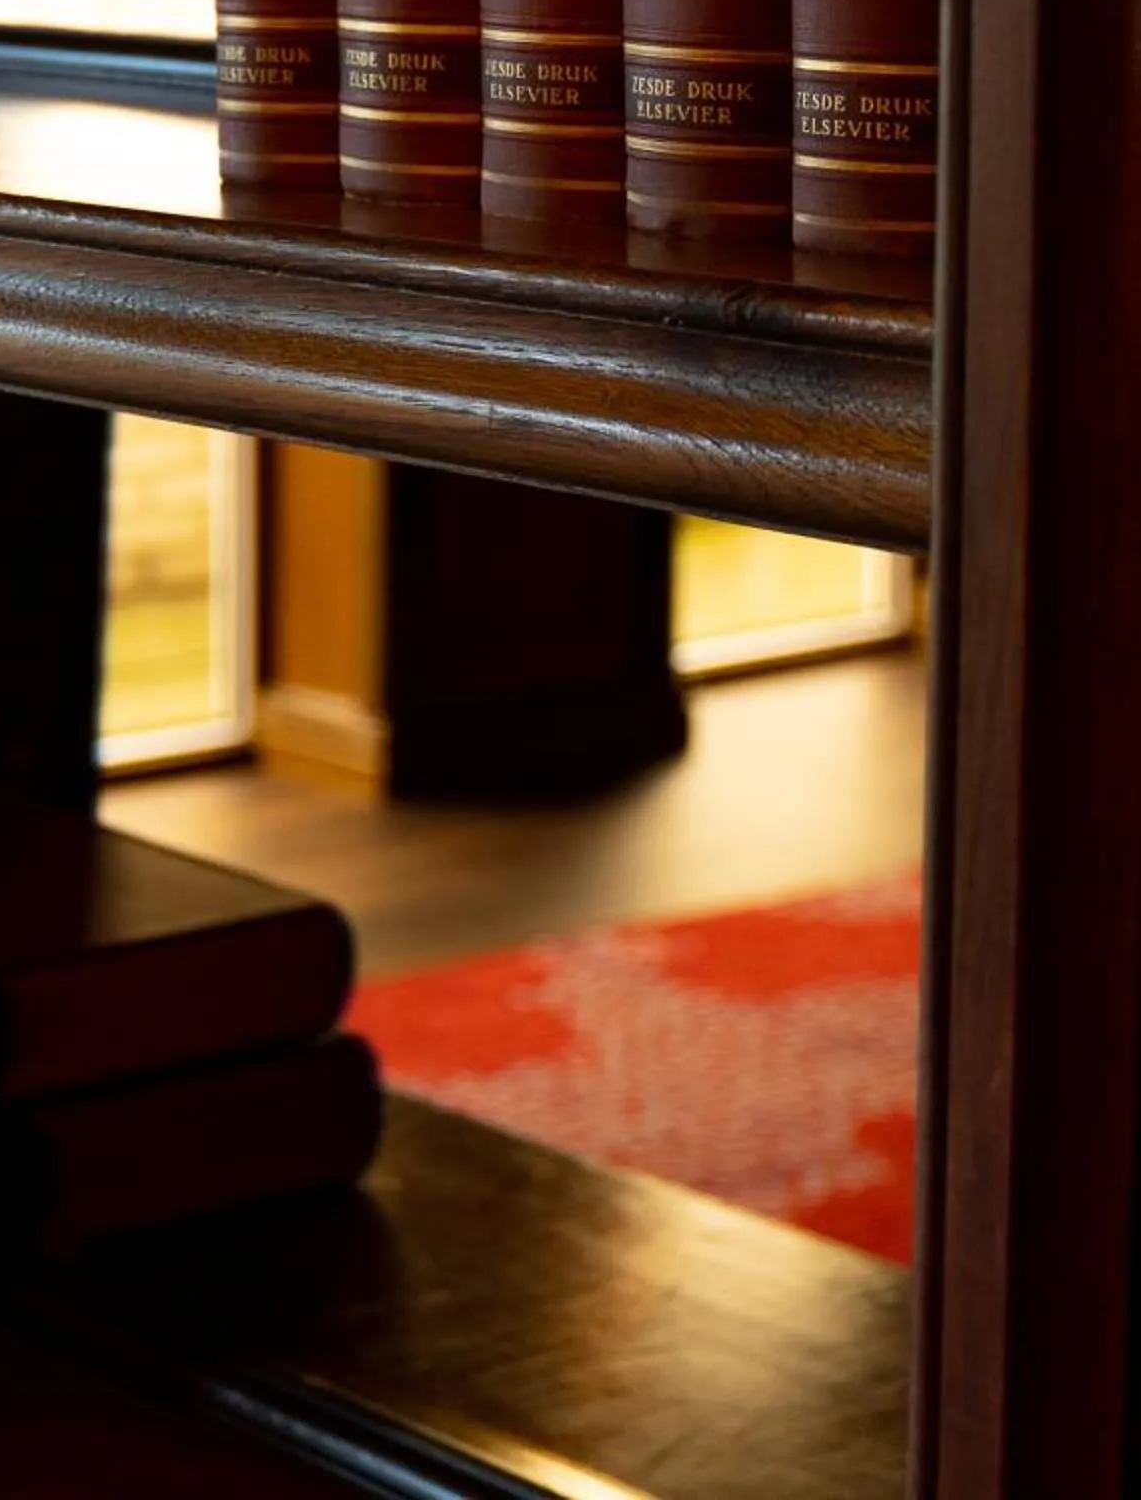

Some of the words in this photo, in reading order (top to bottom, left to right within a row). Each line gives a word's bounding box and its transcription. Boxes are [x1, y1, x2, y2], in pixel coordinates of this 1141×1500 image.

[388, 52, 446, 71] DRUK
[538, 63, 598, 83] DRUK
[490, 83, 580, 106] ELSEVIER
[632, 76, 676, 97] ZESDE
[687, 81, 754, 101] DRUK
[637, 101, 733, 125] ELSEVIER
[860, 96, 933, 116] DRUK
[801, 116, 912, 141] ELSEVIER
